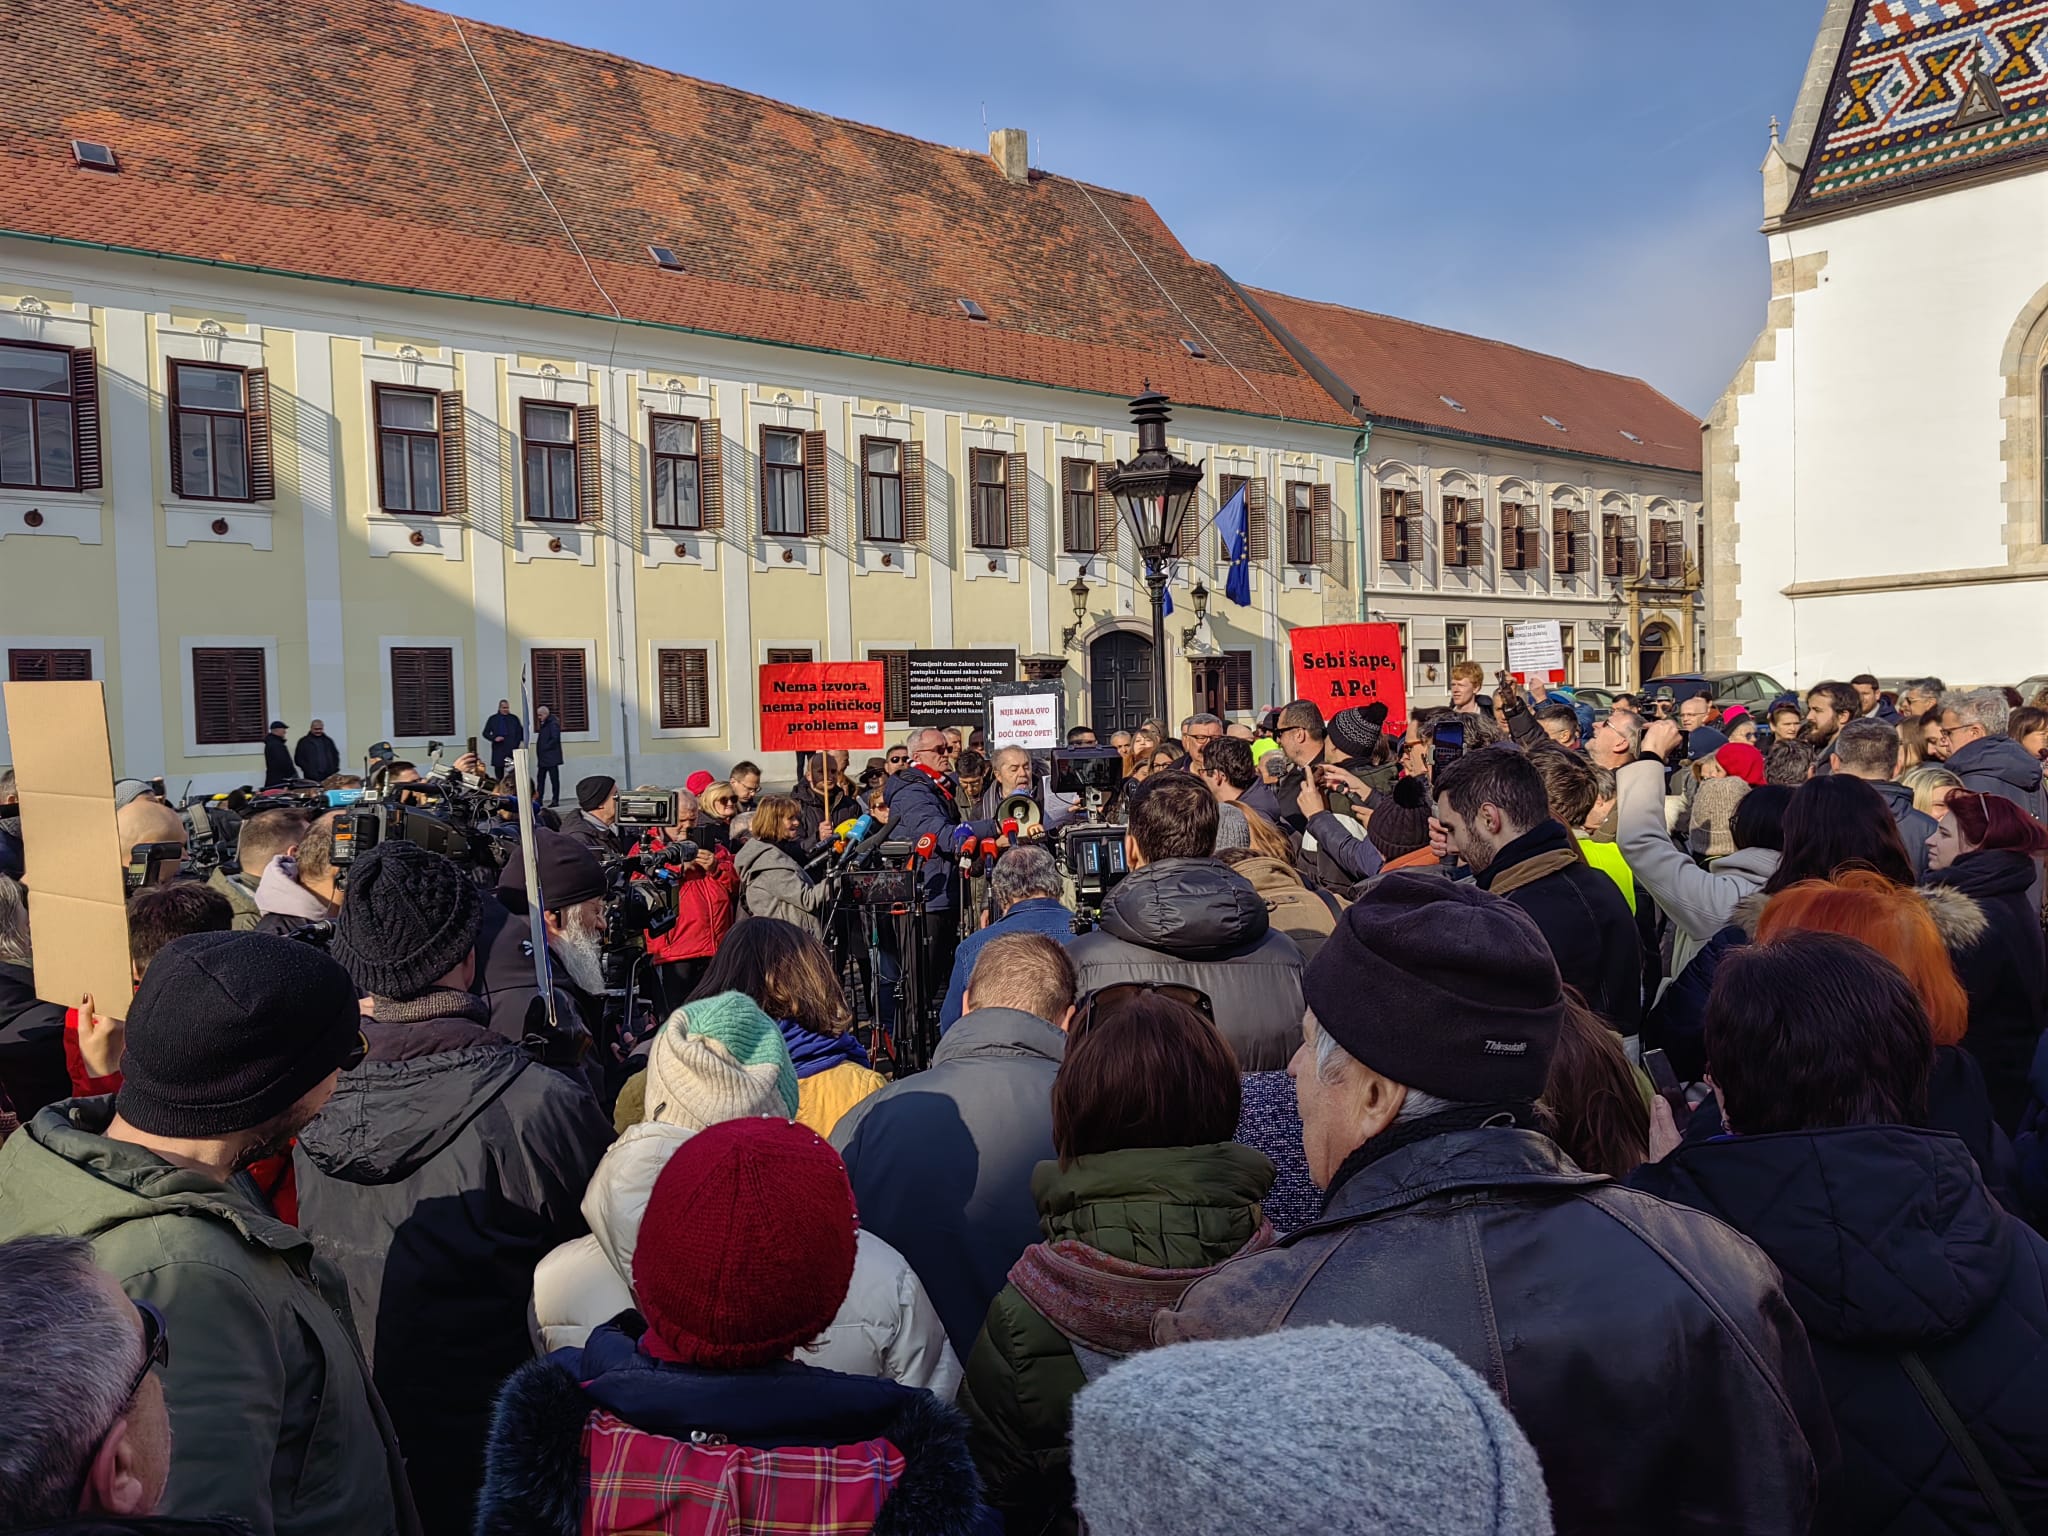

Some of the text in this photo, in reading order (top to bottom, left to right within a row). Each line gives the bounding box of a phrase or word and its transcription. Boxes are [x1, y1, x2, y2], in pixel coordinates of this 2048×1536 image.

[1303, 649, 1396, 671] Sebi šape,
[774, 680, 871, 693] Nema izvora,
[762, 699, 882, 714] nema političkog
[1000, 709, 1014, 717] NIJE
[787, 719, 859, 735] problema
